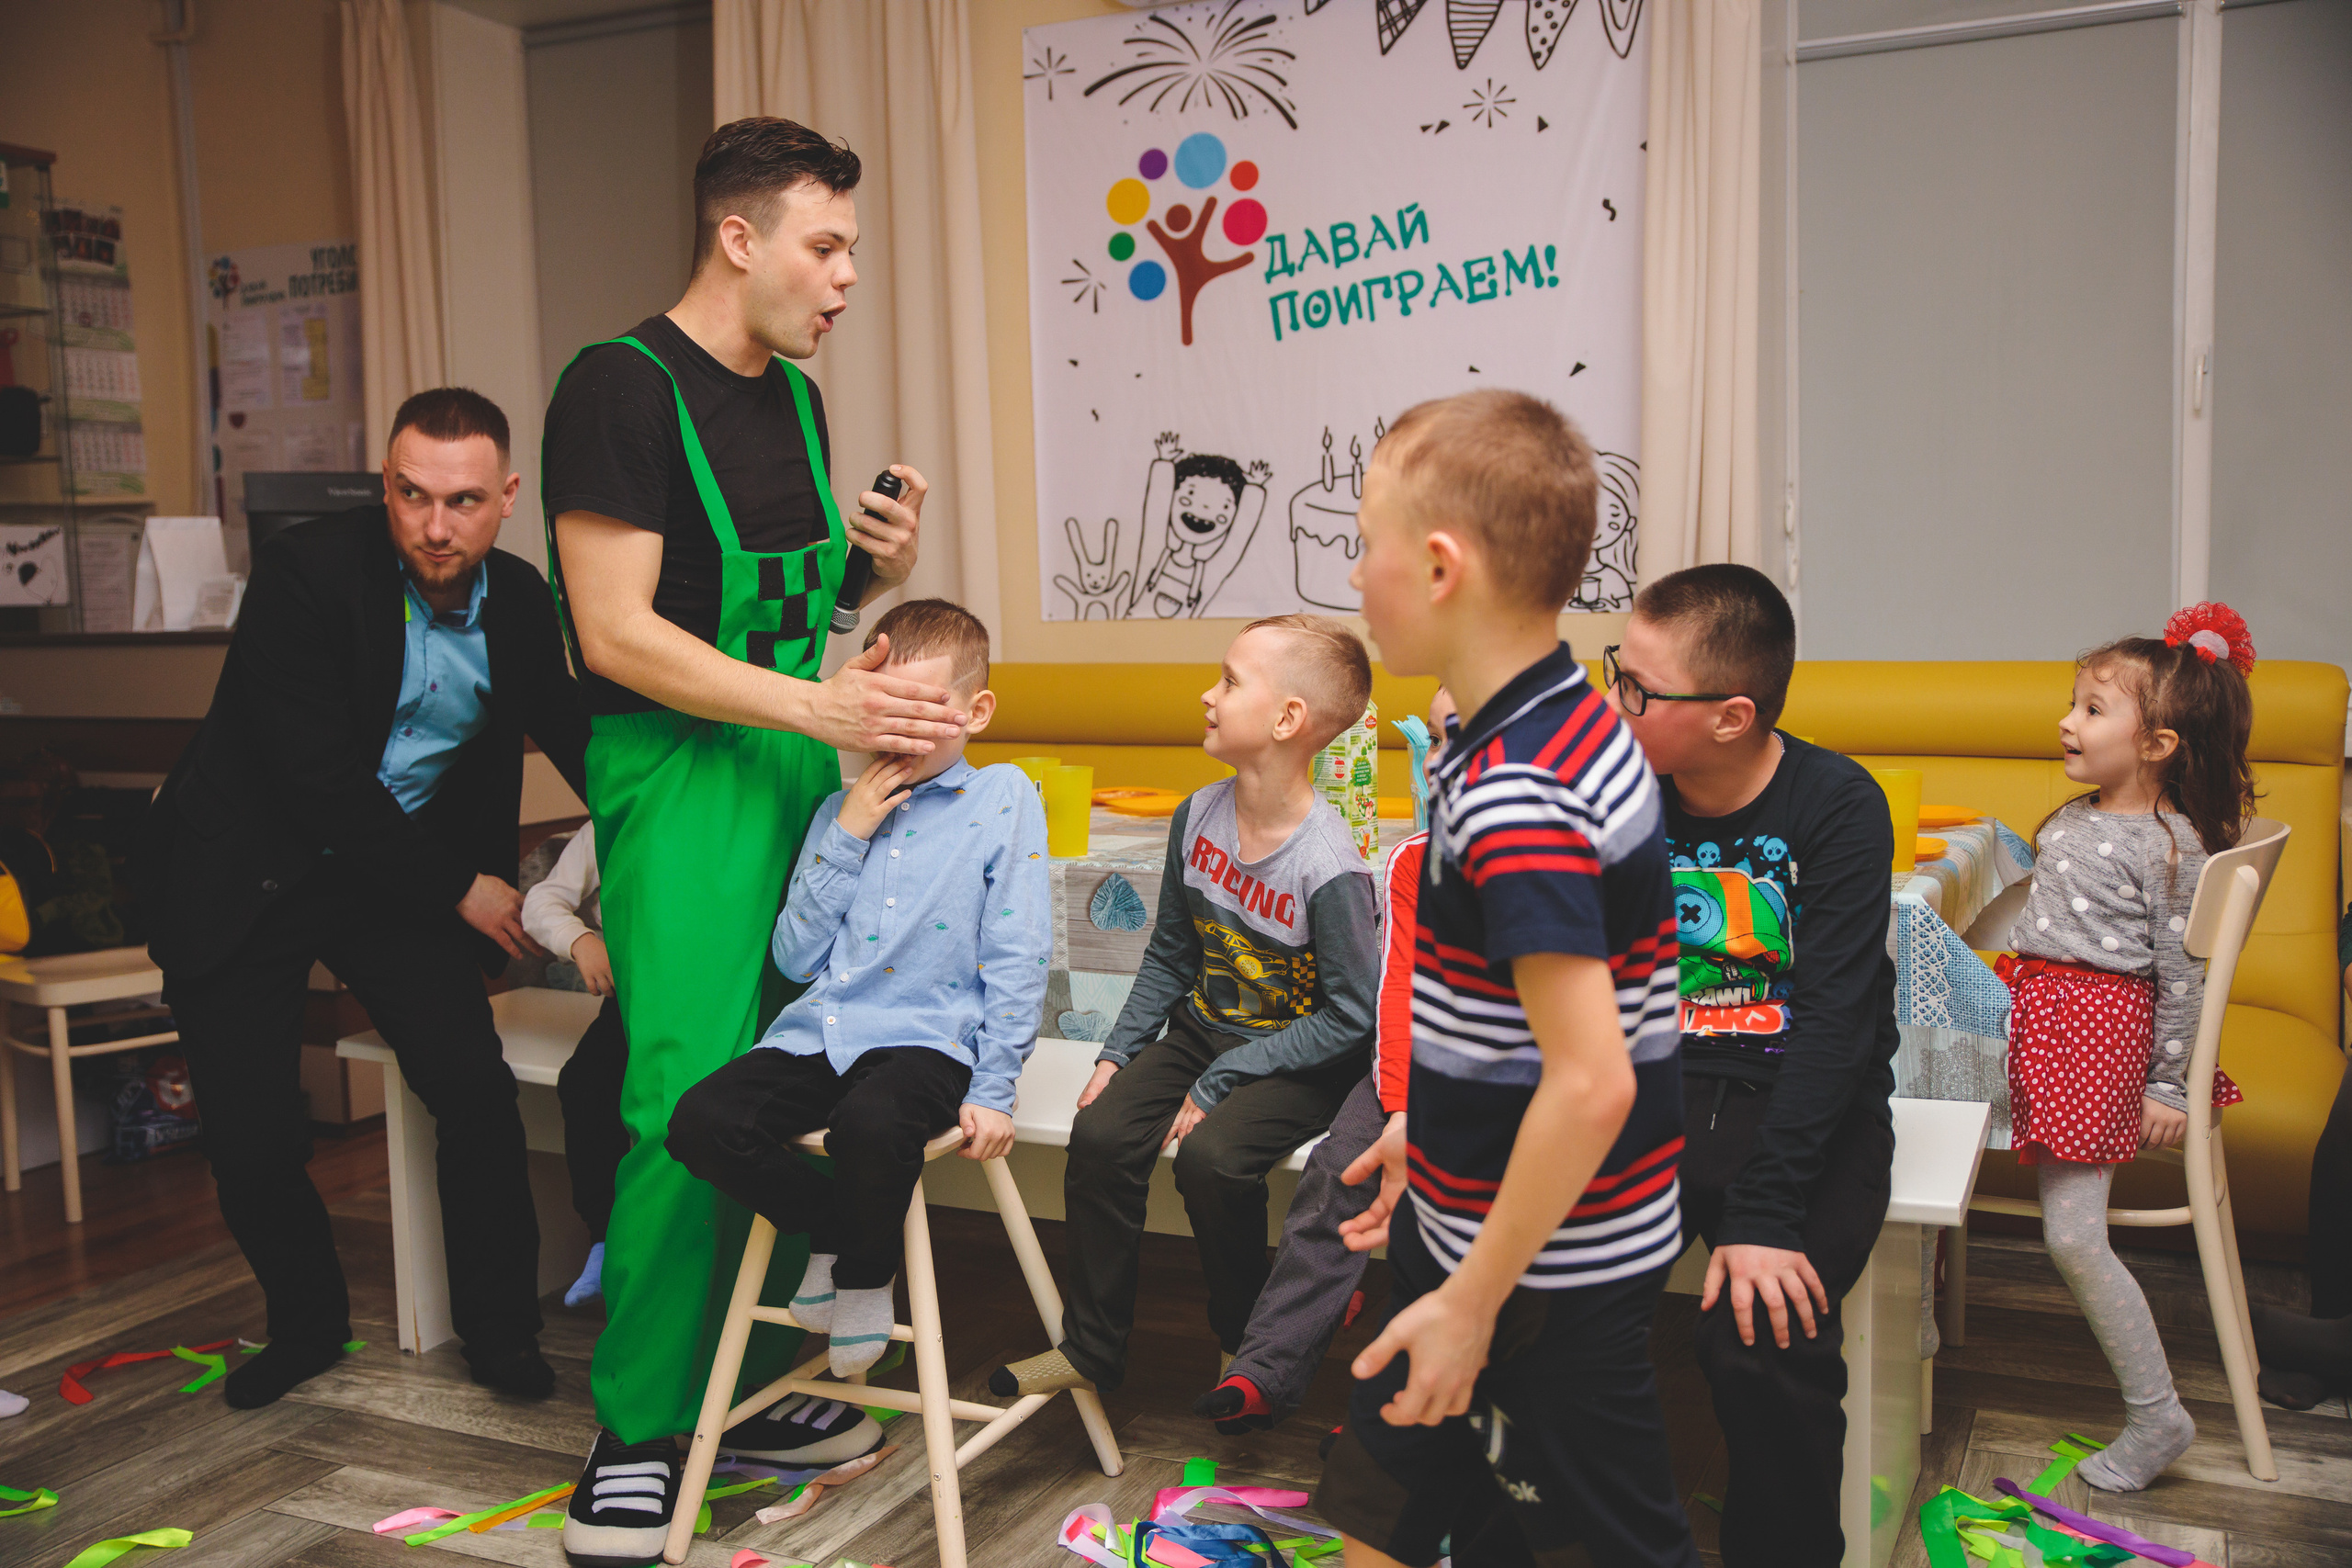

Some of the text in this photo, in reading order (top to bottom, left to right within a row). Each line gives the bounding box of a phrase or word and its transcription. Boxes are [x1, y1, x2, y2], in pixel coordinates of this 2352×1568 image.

[1265, 202, 1429, 284] ДАВАЙ
[1269, 243, 1559, 342] ПОИГРАЕМ!
[1190, 835, 1295, 930] RACING
[1679, 987, 1756, 1007] RAWL
